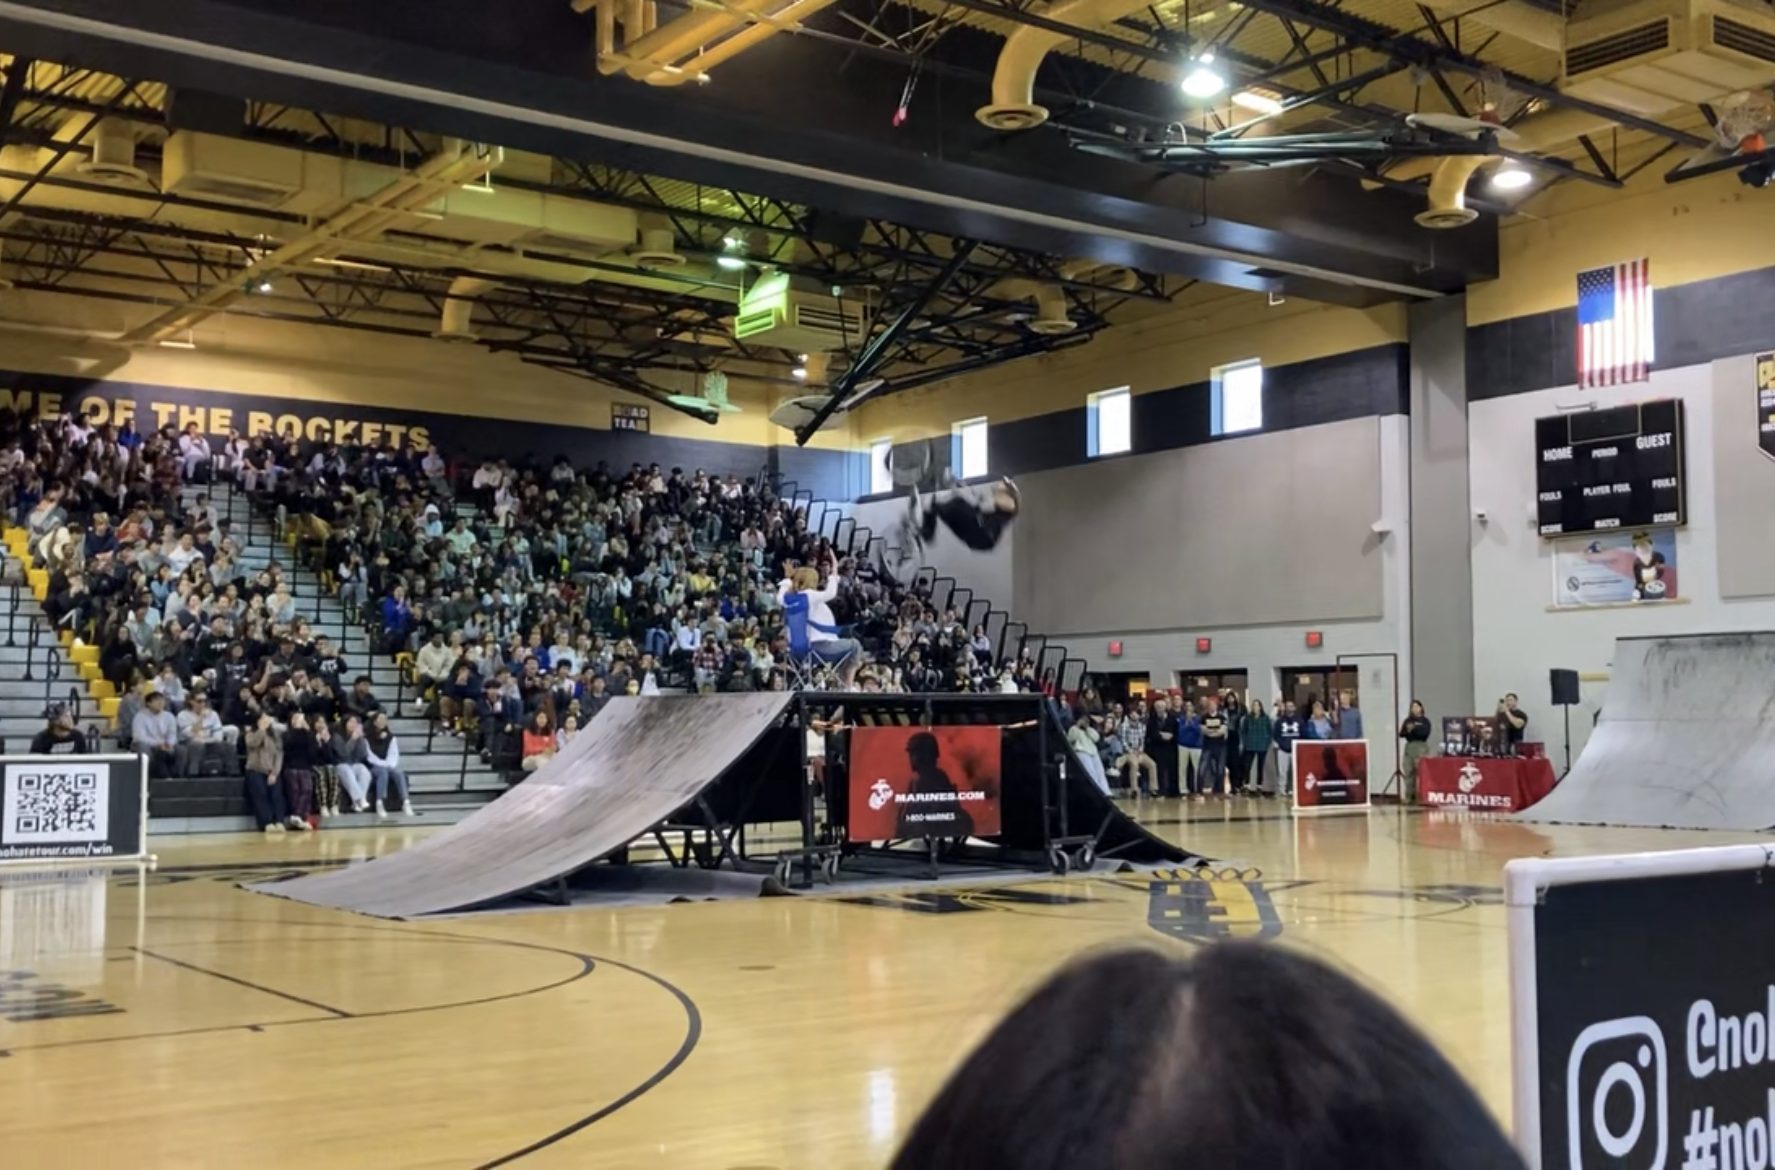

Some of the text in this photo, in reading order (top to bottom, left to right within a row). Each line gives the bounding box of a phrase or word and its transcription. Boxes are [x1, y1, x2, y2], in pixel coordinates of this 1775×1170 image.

[80, 395, 137, 426] OF
[151, 401, 233, 436] THE
[248, 410, 430, 452] ROCKETS
[1636, 432, 1672, 449] GUEST
[1543, 446, 1573, 462] HOME
[1591, 446, 1618, 459] PERIOD
[1583, 483, 1631, 496] PLAYER FOUL
[1652, 477, 1677, 488] FOULS
[1539, 490, 1562, 501] FOULS
[894, 790, 985, 803] MARINES.COM
[1427, 791, 1512, 807] MARINES
[1686, 984, 1775, 1078] @no
[1682, 1086, 1775, 1170] #no
